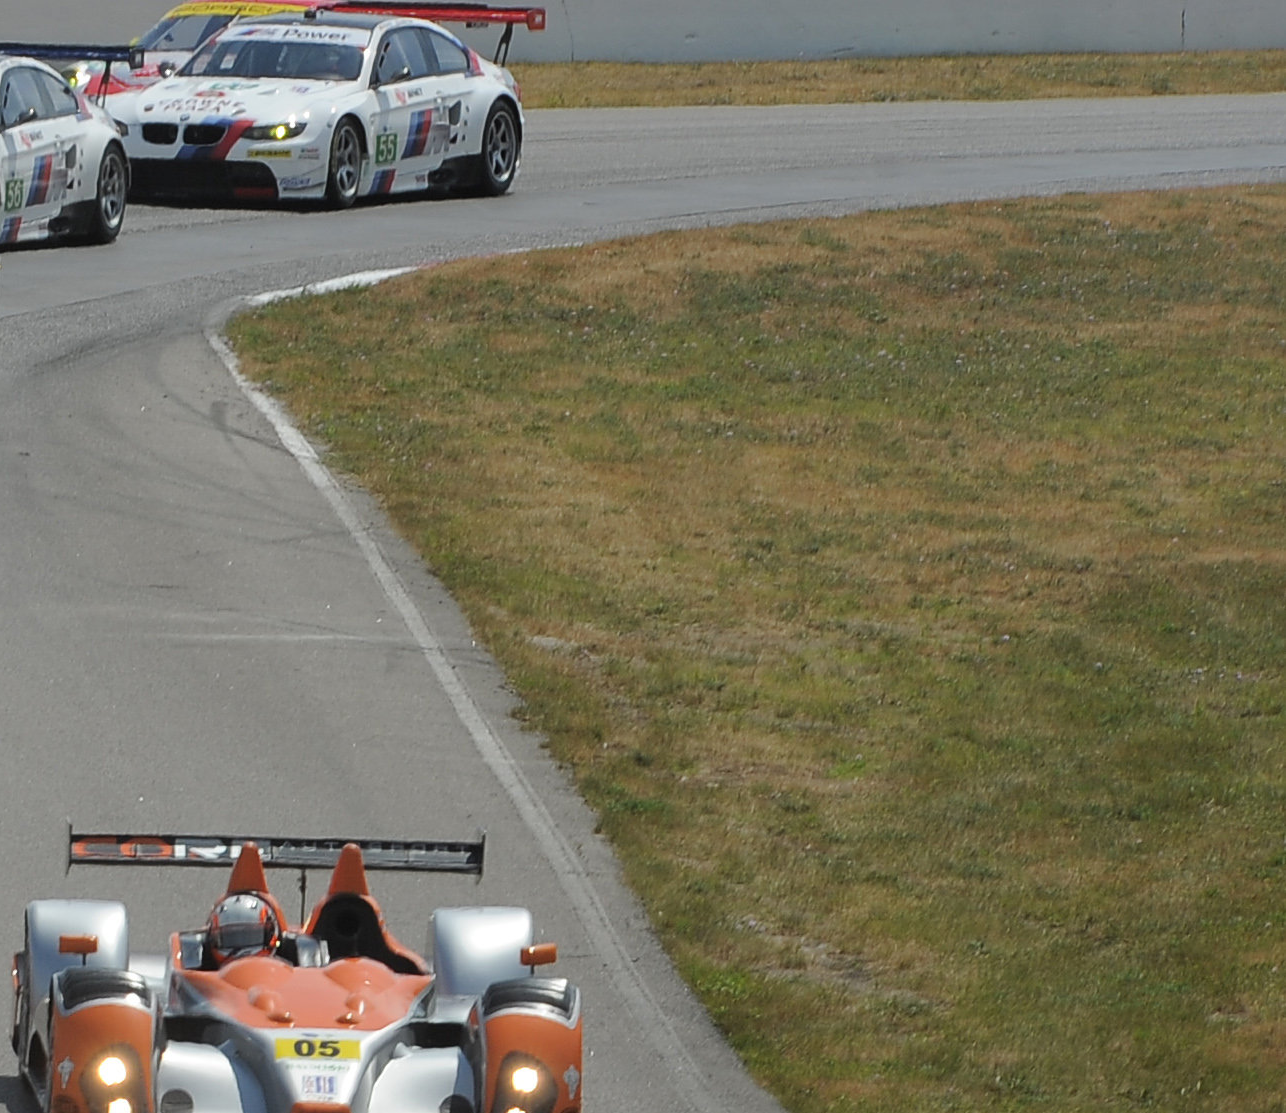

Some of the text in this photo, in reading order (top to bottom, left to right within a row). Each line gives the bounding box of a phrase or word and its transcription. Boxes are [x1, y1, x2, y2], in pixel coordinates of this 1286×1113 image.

[281, 28, 348, 41] Power
[378, 135, 395, 162] 55
[7, 182, 22, 208] 56
[294, 1040, 341, 1057] 05
